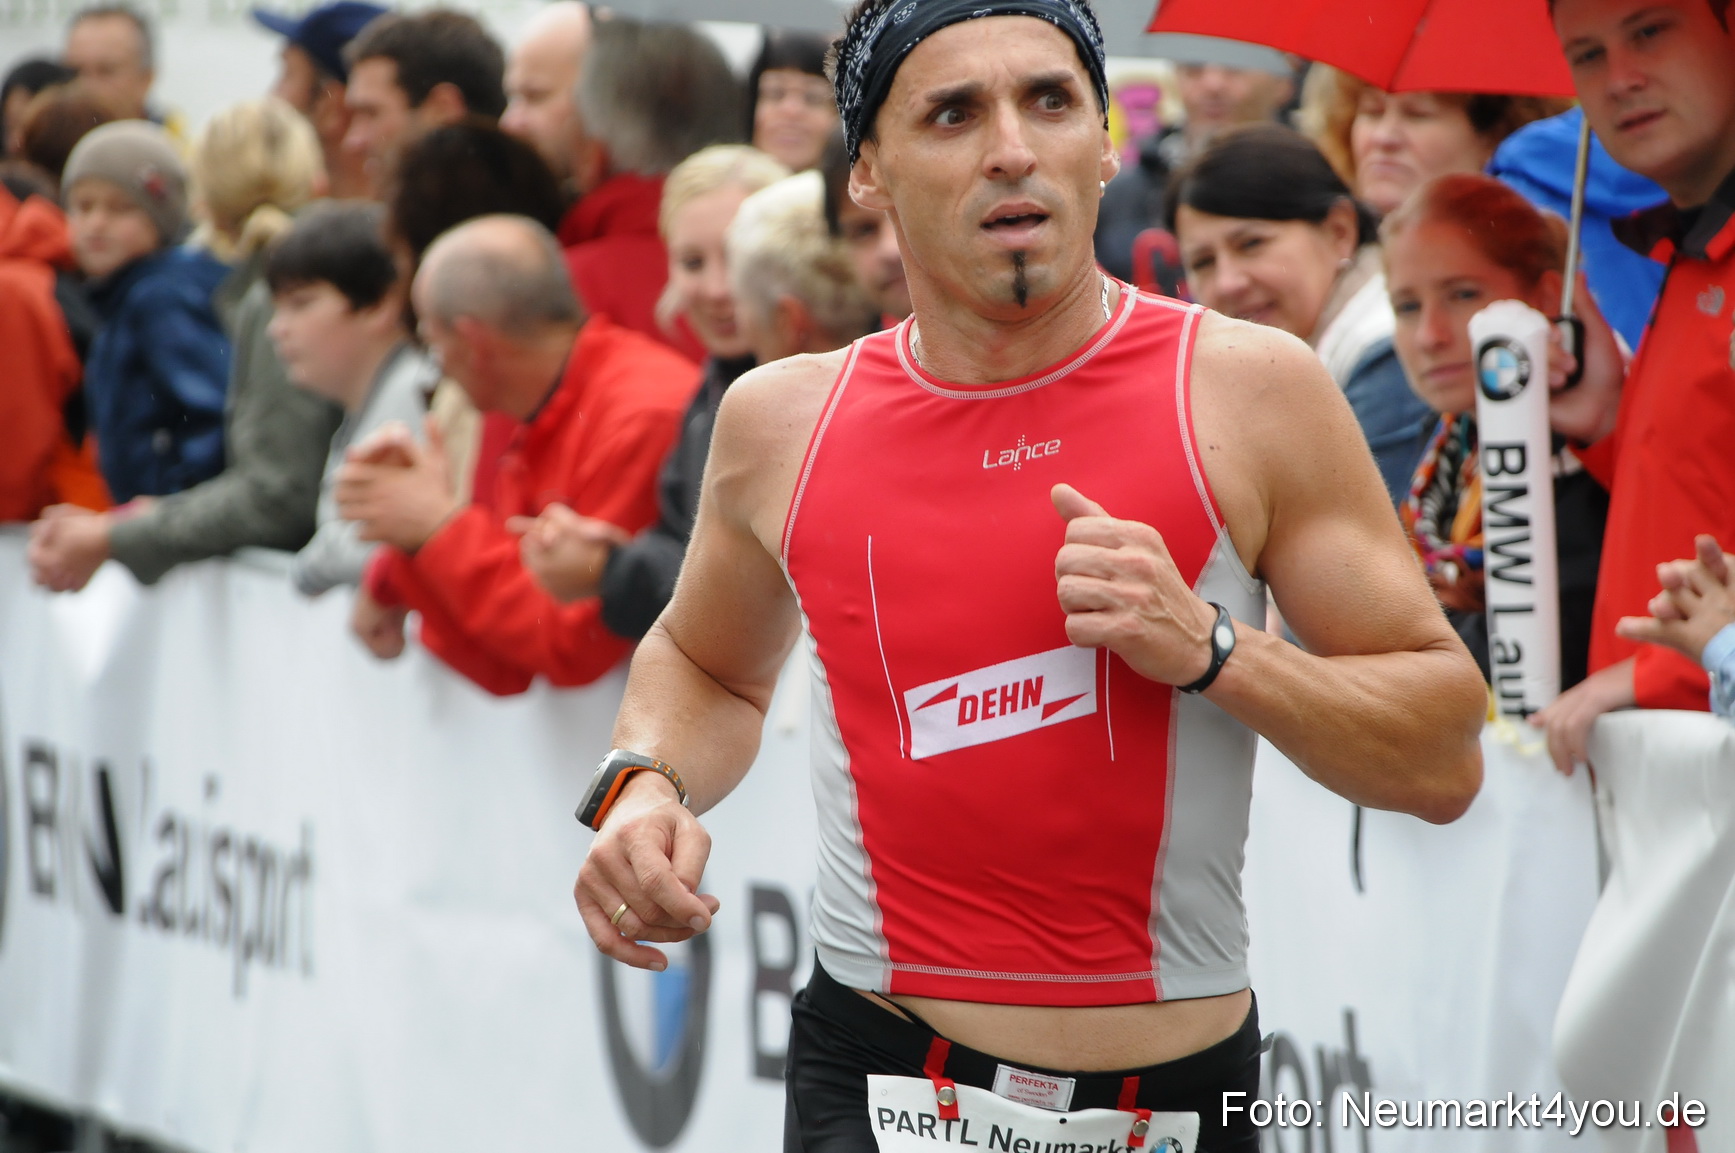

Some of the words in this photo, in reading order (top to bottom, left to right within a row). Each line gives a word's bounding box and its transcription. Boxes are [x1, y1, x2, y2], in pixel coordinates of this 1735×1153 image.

[982, 438, 1062, 470] Lance
[1484, 442, 1533, 586] BMW
[957, 675, 1044, 727] DEHN
[1009, 1073, 1059, 1092] PERFEKTA
[877, 1107, 978, 1147] PARTL
